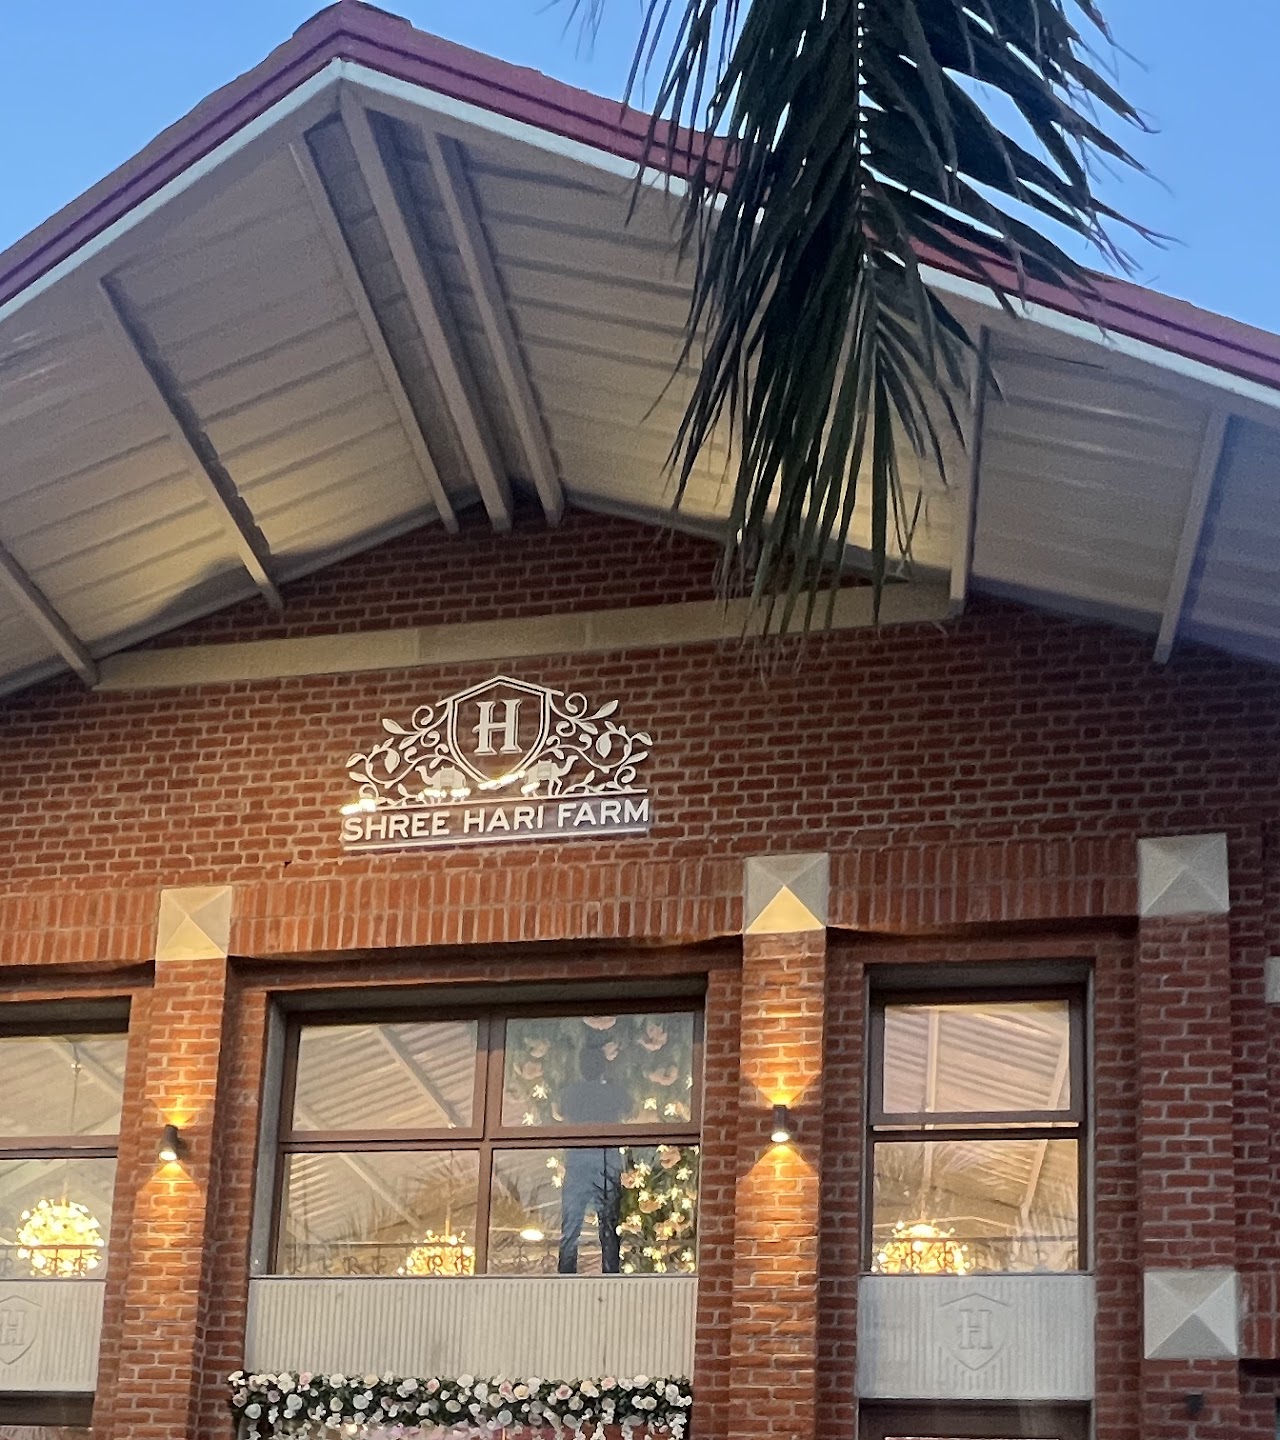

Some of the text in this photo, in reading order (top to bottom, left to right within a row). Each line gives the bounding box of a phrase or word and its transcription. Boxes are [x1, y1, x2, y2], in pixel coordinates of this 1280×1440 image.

[473, 699, 523, 756] H
[342, 798, 649, 841] SHREE HARI FARM
[957, 1309, 993, 1349] H
